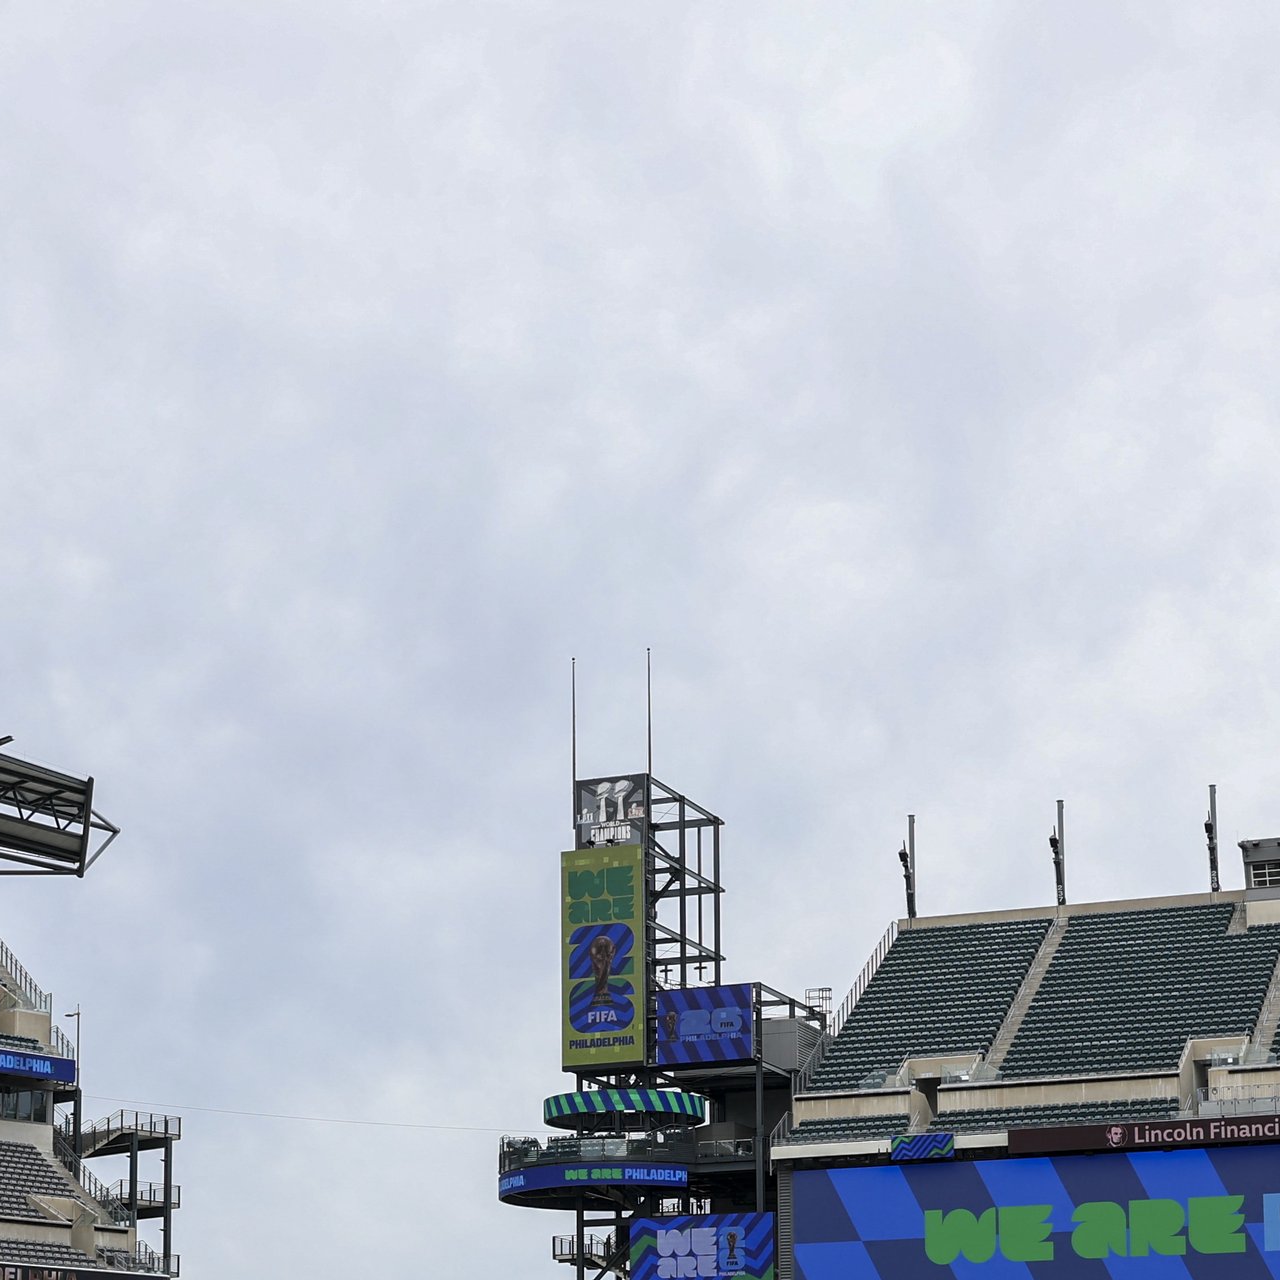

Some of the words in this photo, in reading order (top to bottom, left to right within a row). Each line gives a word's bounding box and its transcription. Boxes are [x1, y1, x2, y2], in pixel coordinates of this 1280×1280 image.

[591, 825, 630, 842] CHAMPIONS
[568, 866, 634, 899] WE
[569, 897, 634, 924] ARE
[588, 1010, 618, 1024] FIFA
[720, 1020, 735, 1028] FIFA
[569, 1036, 634, 1050] PHILADELPHIA
[680, 1032, 742, 1042] PHILADELPHIA
[1134, 1122, 1204, 1144] Lincoln
[564, 1169, 588, 1180] WE
[591, 1168, 623, 1180] ARE
[924, 1204, 1054, 1266] WE
[1071, 1194, 1246, 1260] ARE
[657, 1227, 717, 1257] WE
[657, 1254, 718, 1278] ARE
